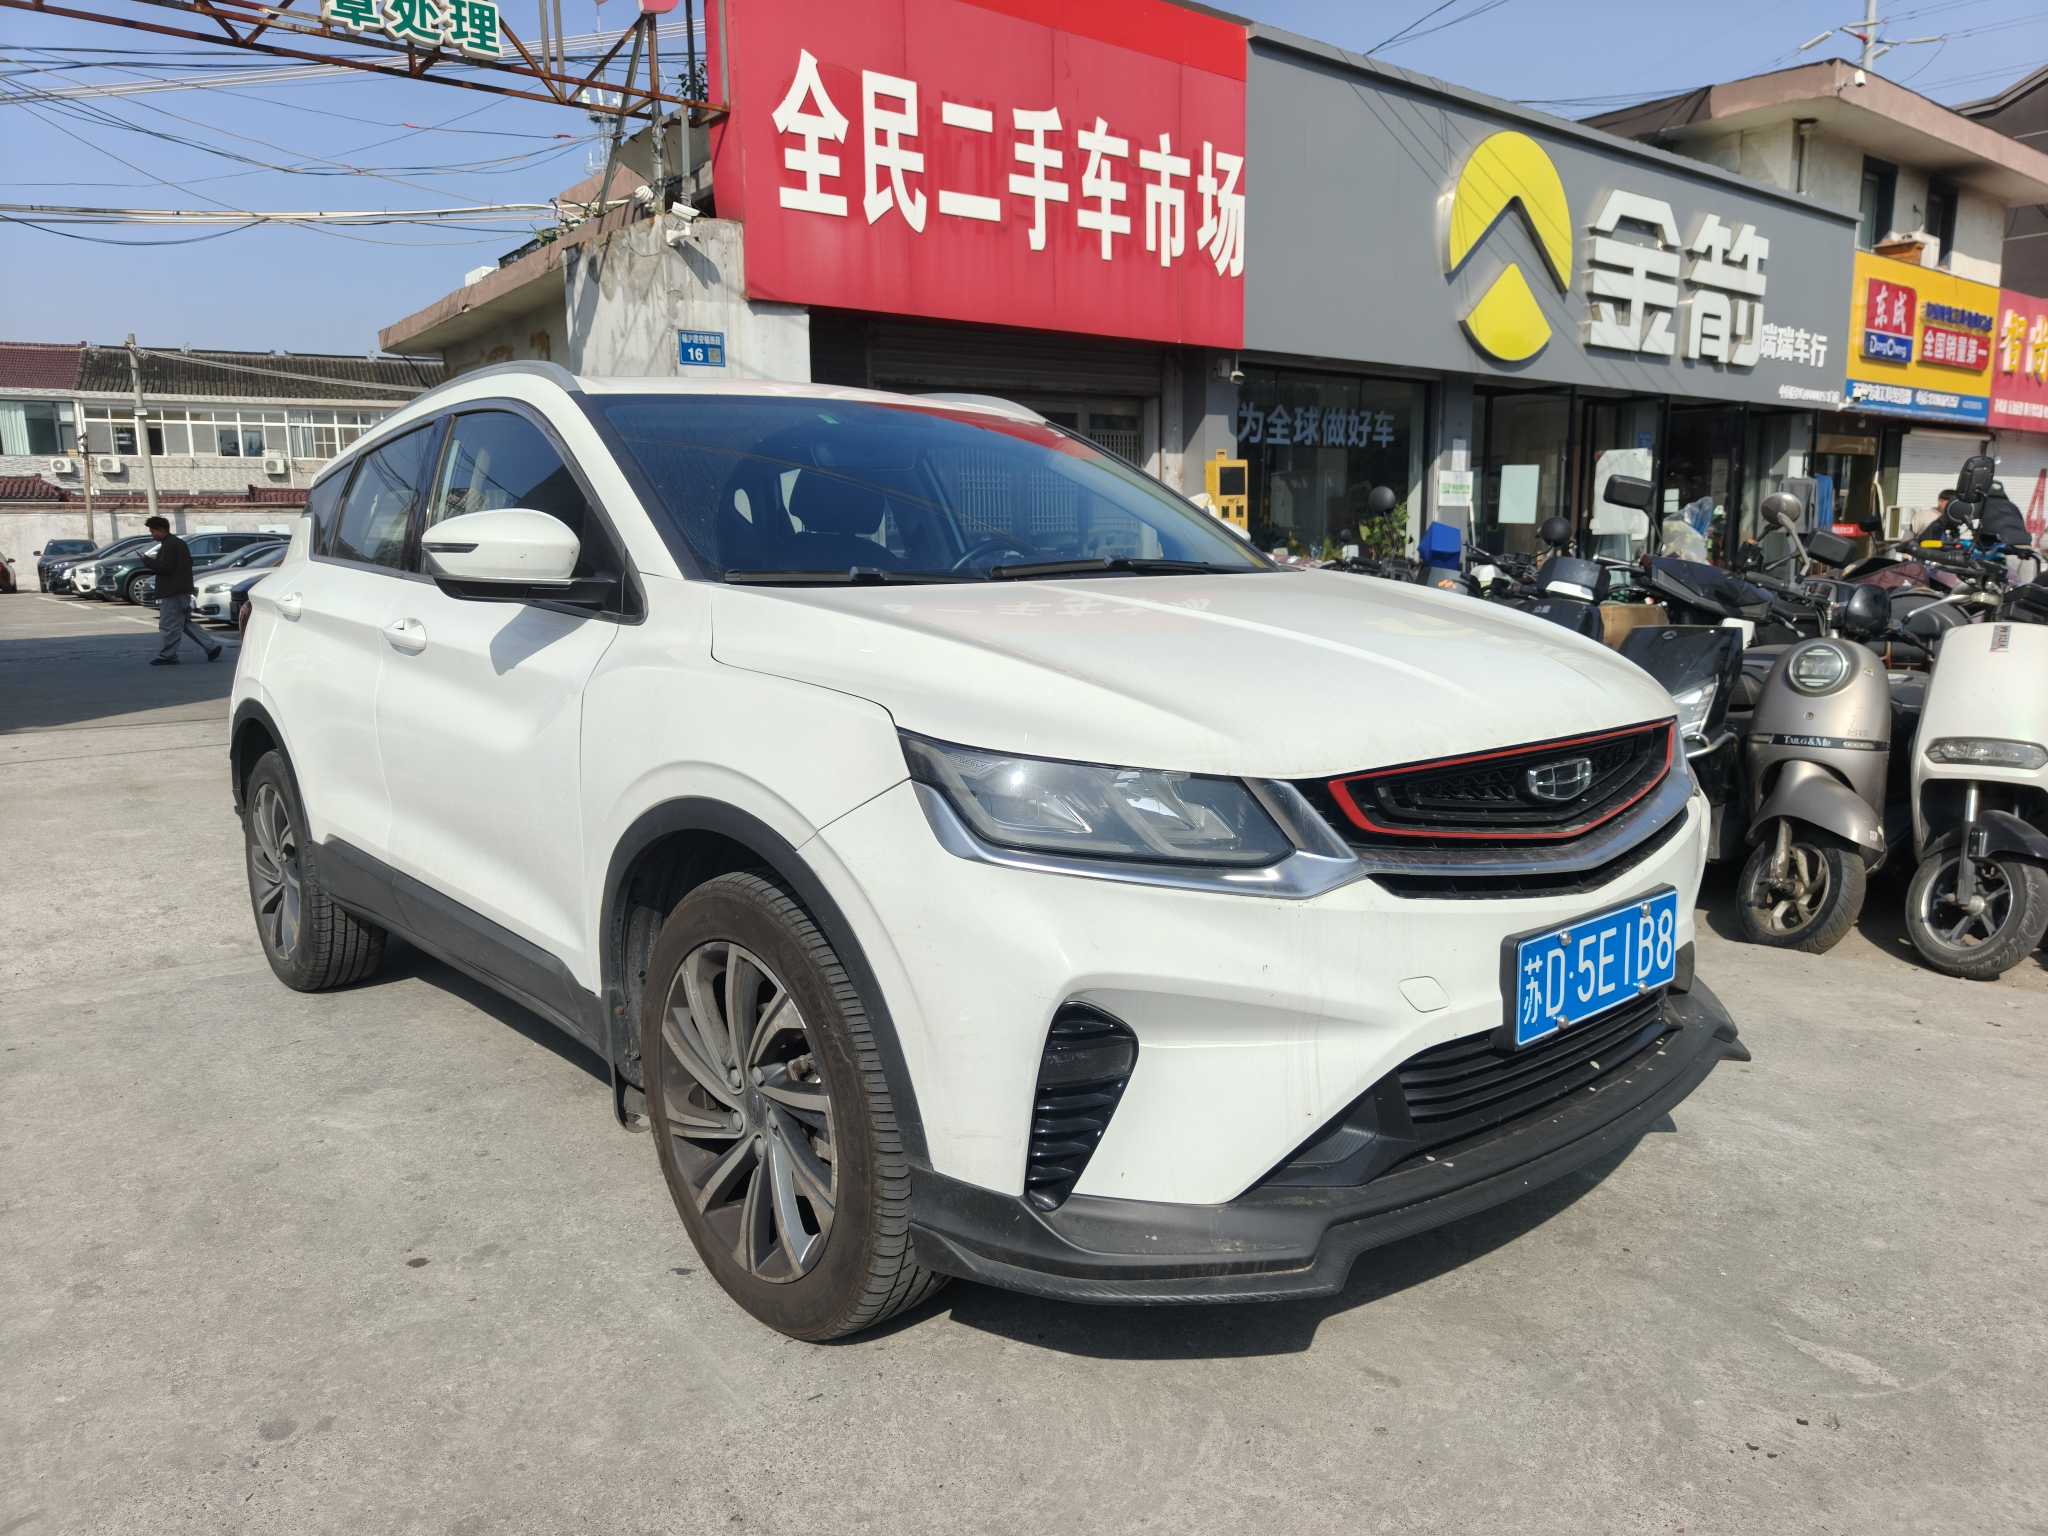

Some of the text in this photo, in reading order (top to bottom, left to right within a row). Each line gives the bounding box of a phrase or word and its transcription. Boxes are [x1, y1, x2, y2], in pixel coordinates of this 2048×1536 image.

[771, 48, 1246, 278] 全民二手车市场
[1590, 189, 1770, 367] 金箭
[1874, 284, 1908, 334] 东成
[687, 347, 704, 361] 16
[1922, 329, 1988, 365] 全国销量第一
[1237, 402, 1396, 449] 为全球做好车
